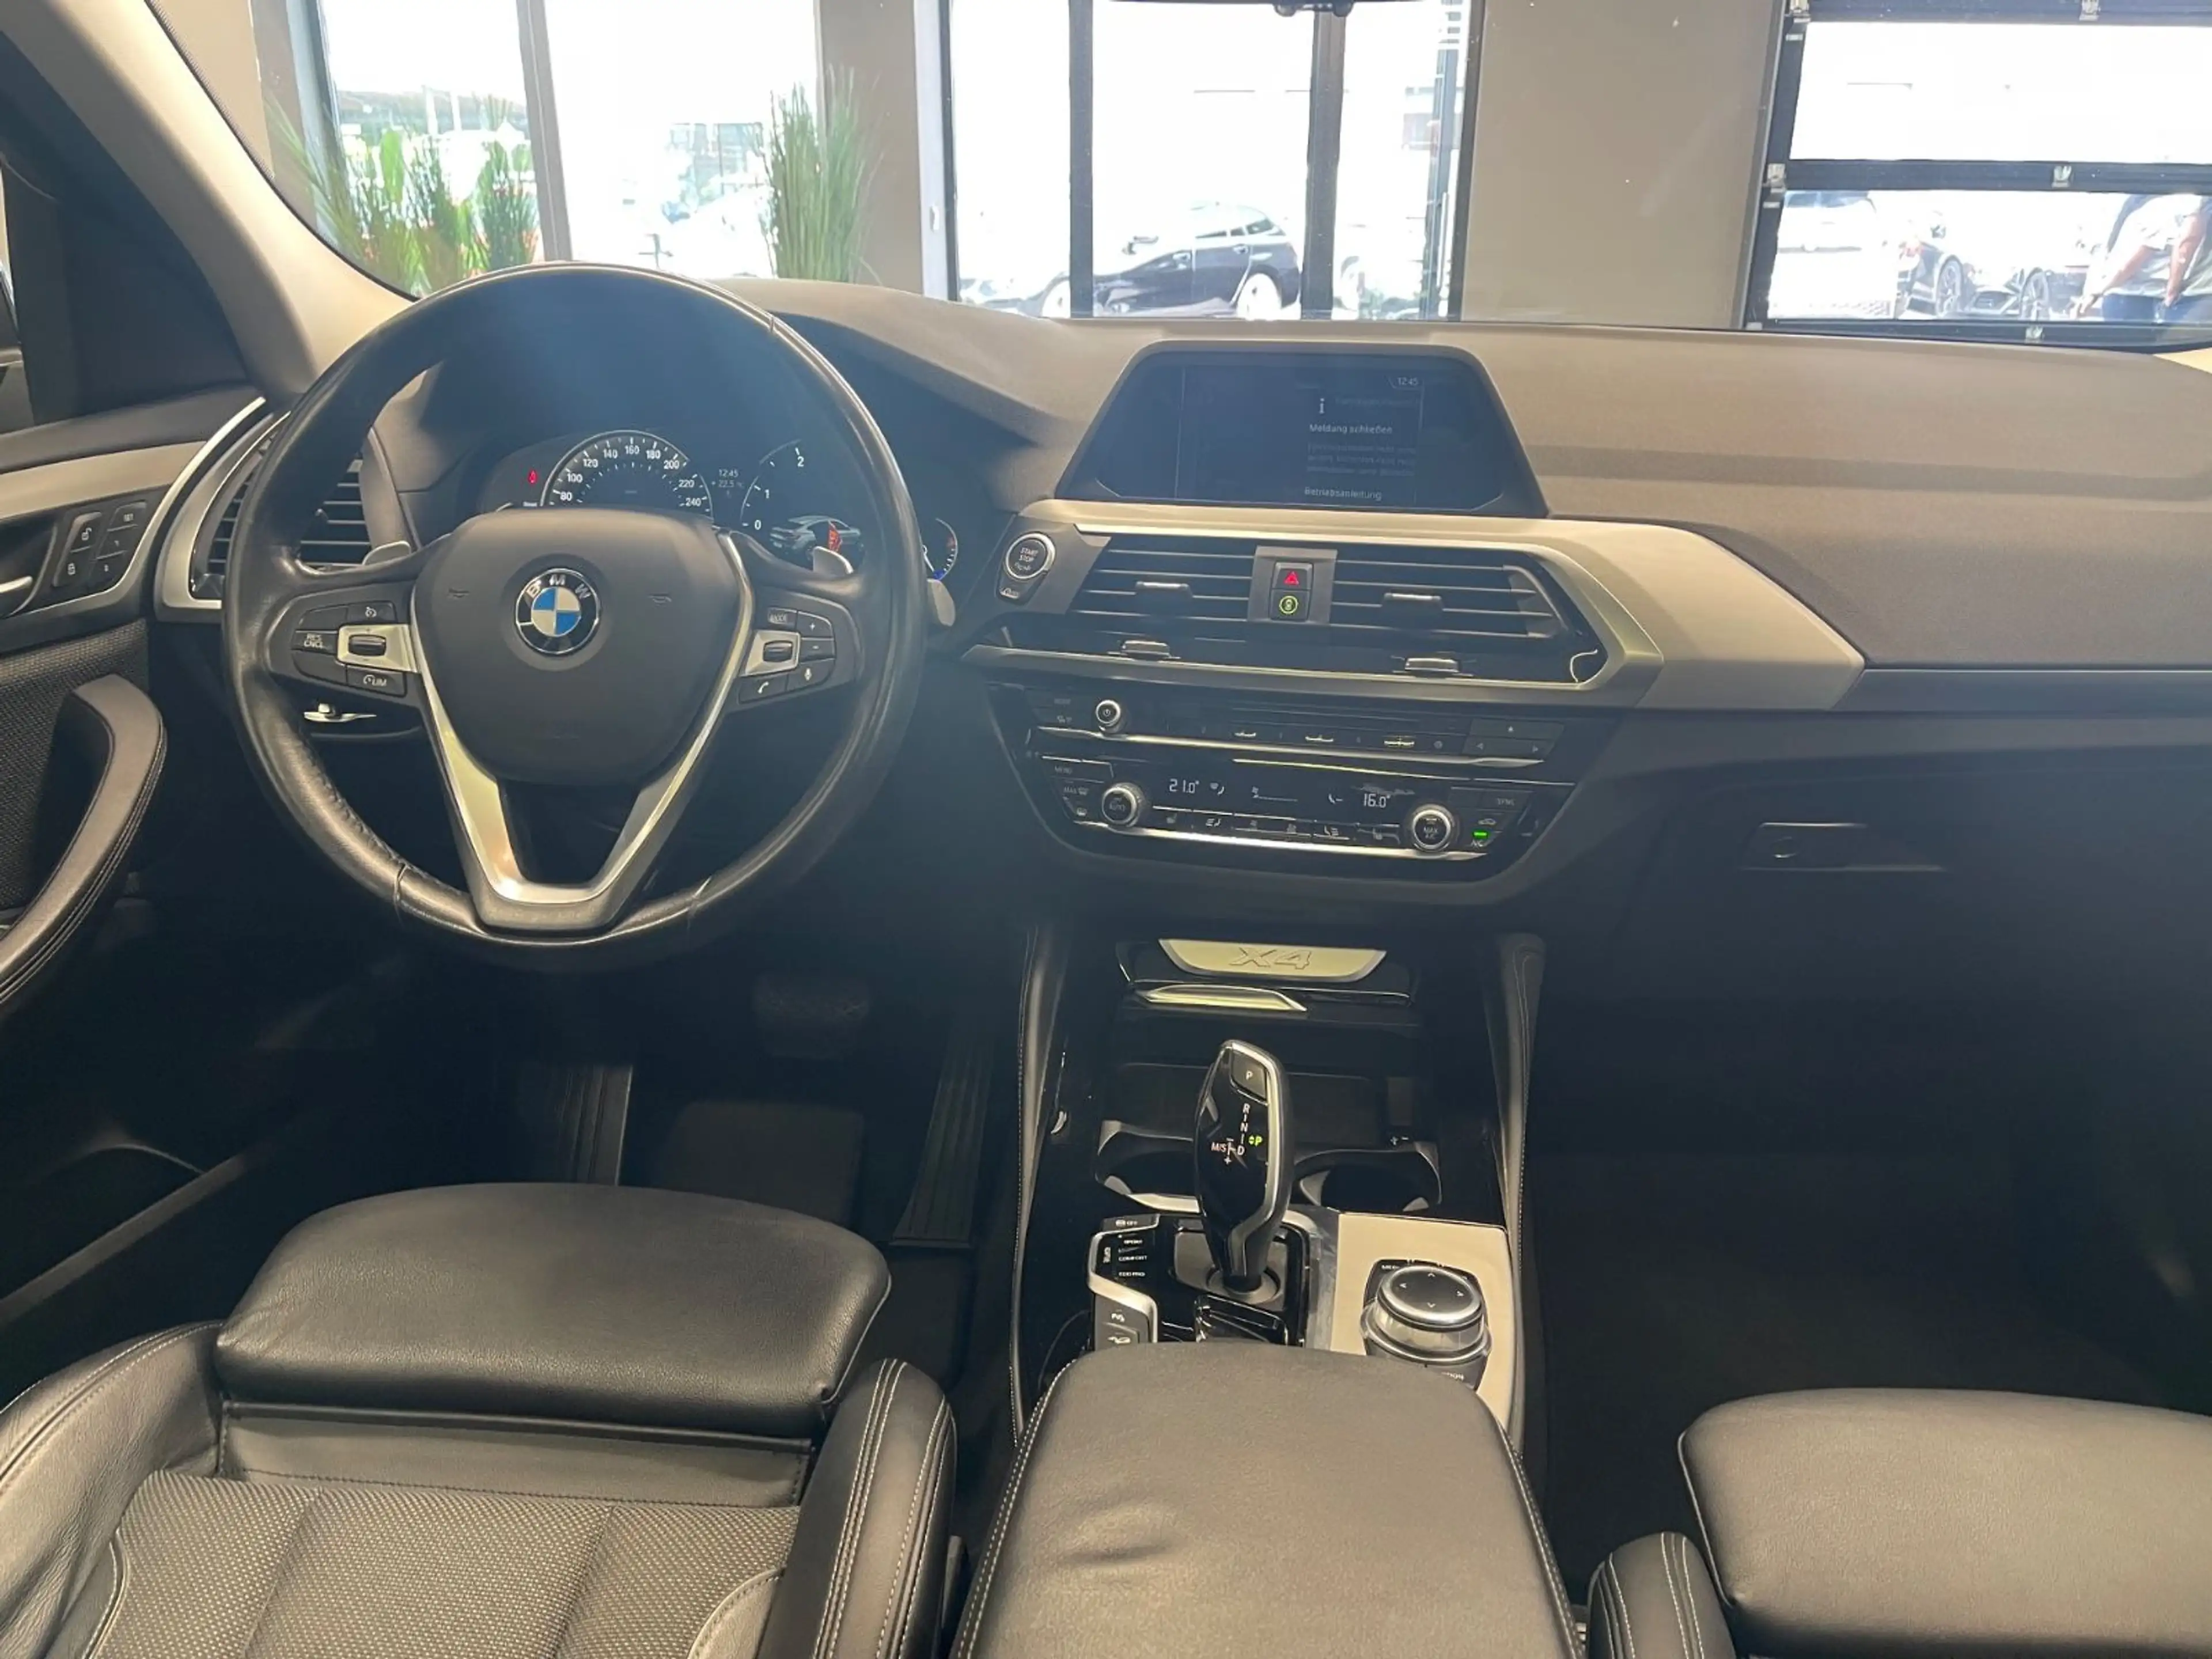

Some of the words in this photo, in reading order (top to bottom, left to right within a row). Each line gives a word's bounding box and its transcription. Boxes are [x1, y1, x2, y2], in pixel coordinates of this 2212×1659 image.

[604, 449, 618, 459] 140
[625, 445, 639, 454] 160
[646, 450, 661, 459] 180
[583, 459, 598, 468] 120
[664, 460, 680, 469] 200
[797, 456, 804, 467] 2
[567, 472, 583, 483] 100
[679, 479, 695, 488] 220
[560, 491, 573, 501] 80
[765, 489, 770, 499] 1
[685, 497, 702, 506] 240
[755, 520, 762, 530] 0
[527, 574, 591, 599] BMW
[1229, 947, 1312, 970] X4
[1245, 1070, 1253, 1080] P
[1243, 1103, 1250, 1114] R
[1240, 1123, 1248, 1132] N
[1255, 1135, 1263, 1146] P
[1237, 1145, 1245, 1155] D
